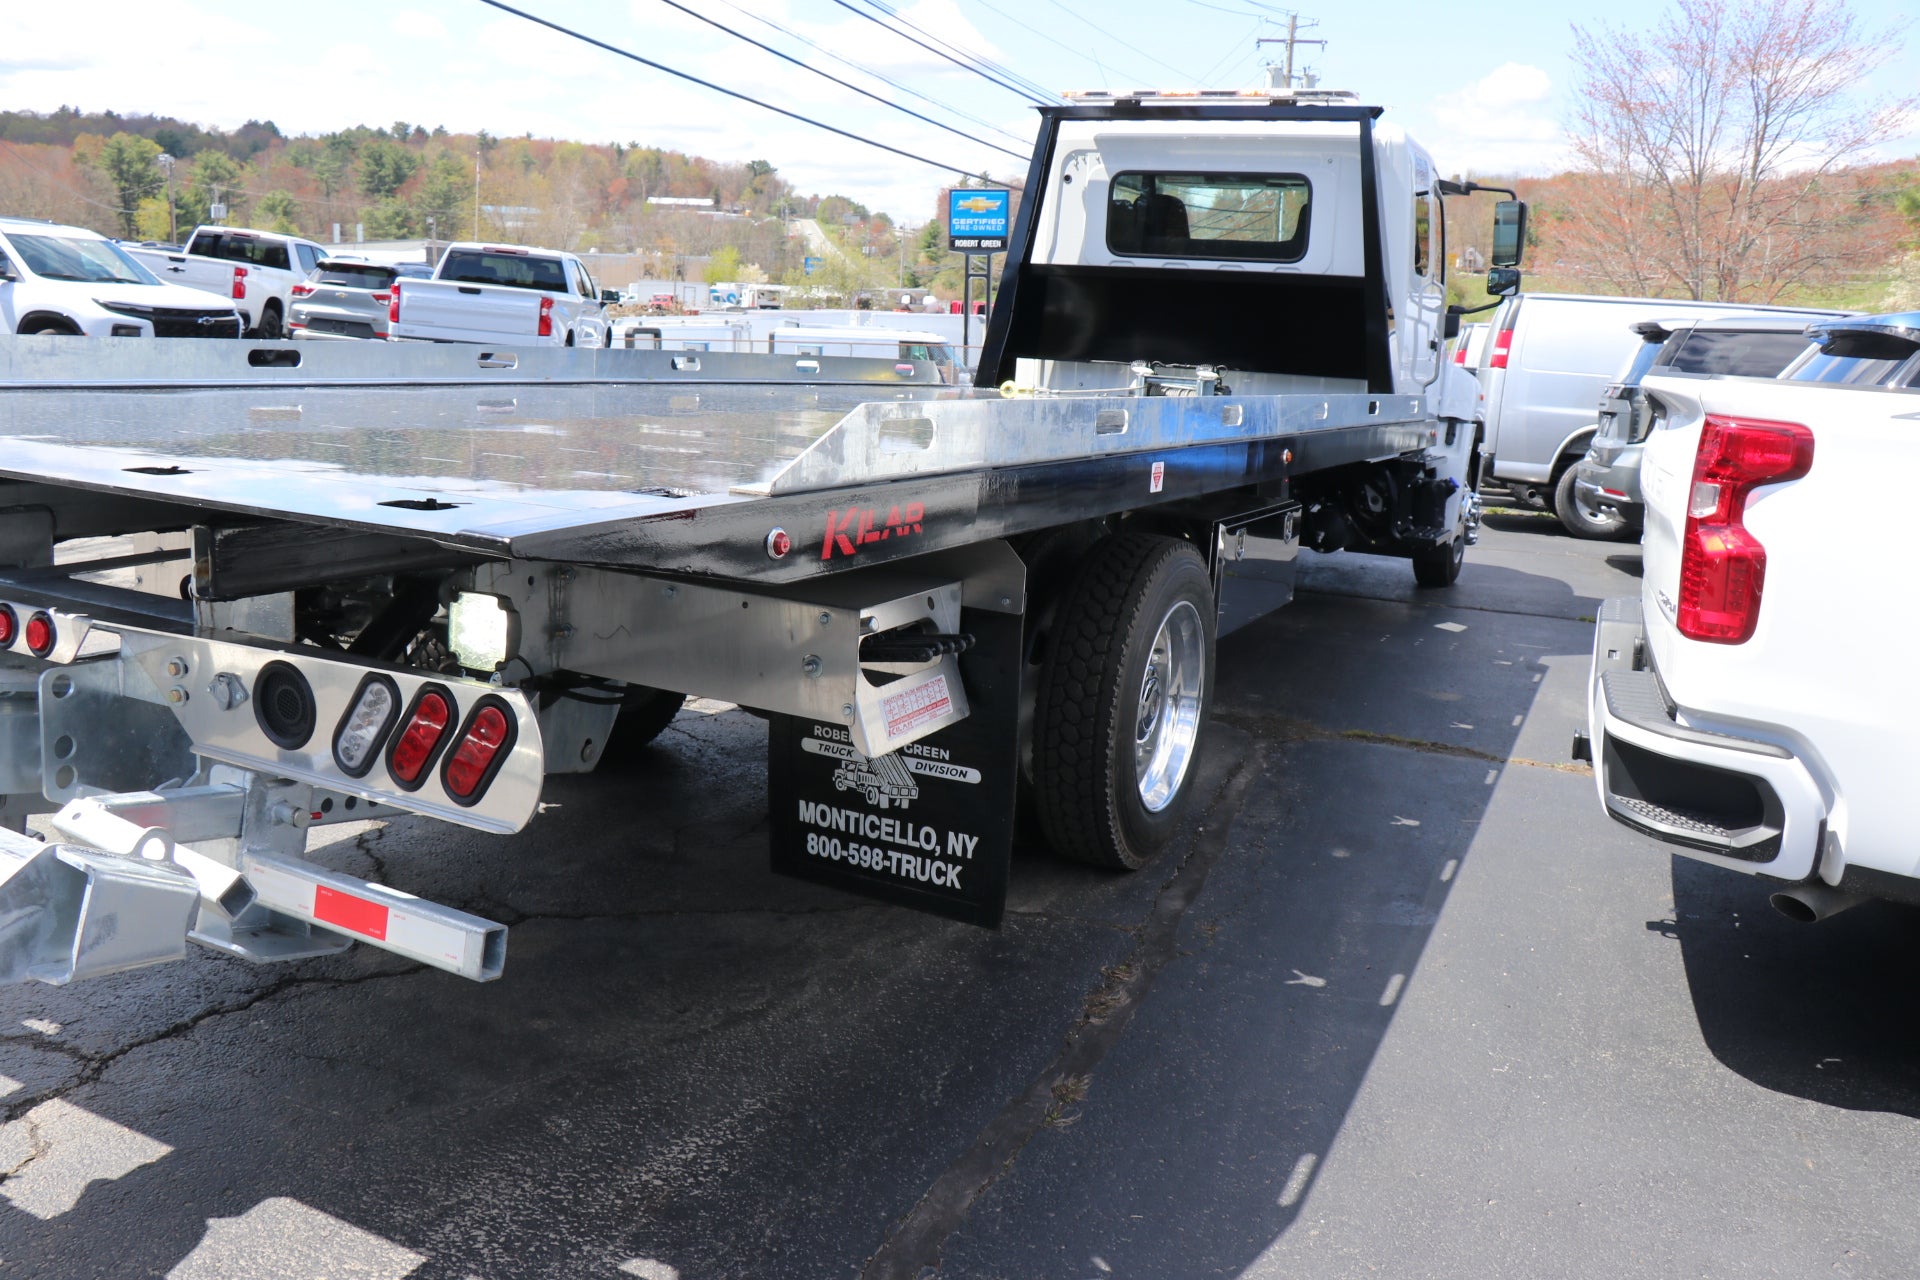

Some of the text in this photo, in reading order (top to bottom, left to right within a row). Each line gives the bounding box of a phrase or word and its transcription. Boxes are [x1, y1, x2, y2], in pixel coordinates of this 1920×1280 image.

[954, 239, 1002, 248] ROBERT GREEN
[821, 501, 925, 561] KILAR
[813, 724, 950, 761] ROBE GREEN
[818, 742, 968, 779] TRUCK DIVISION
[798, 800, 979, 859] MONTICELLO, NY
[806, 832, 963, 890] 800-598-TRUCK
